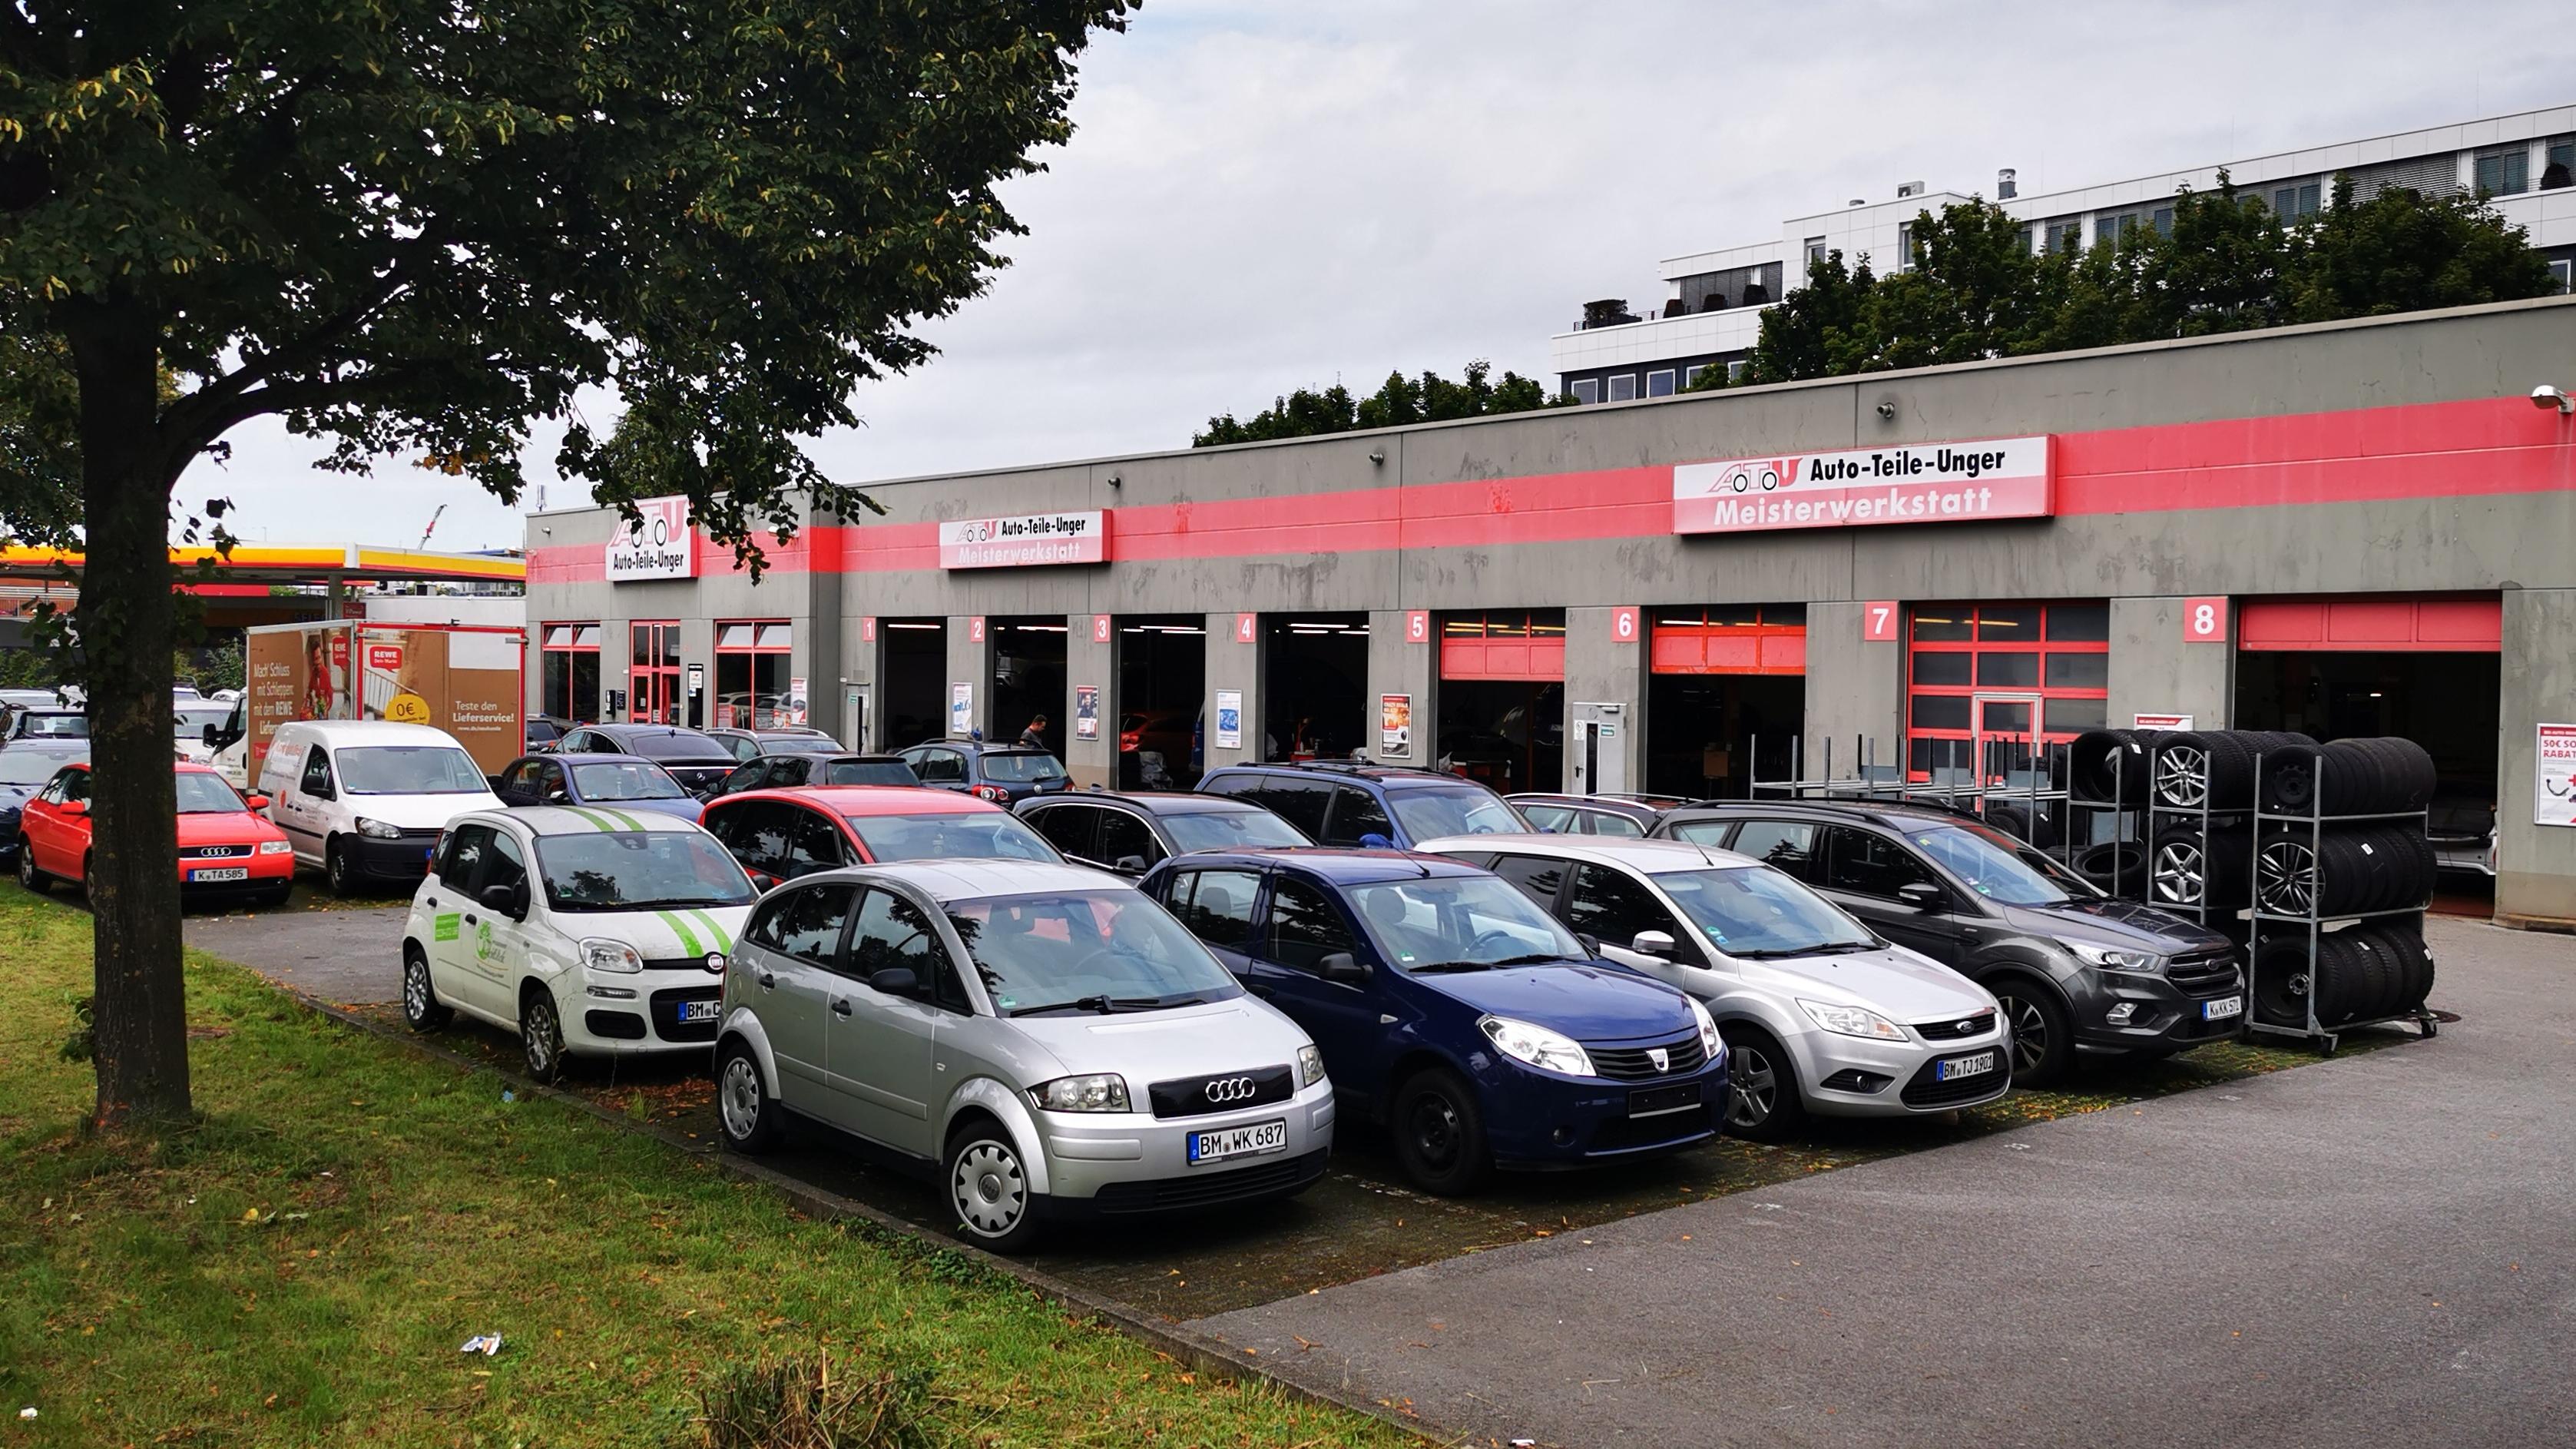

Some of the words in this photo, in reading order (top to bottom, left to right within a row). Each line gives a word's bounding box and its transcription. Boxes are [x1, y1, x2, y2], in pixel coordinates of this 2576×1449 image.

[1810, 449, 2005, 482] Auto-Teile-Unger
[1713, 487, 1992, 526] Meisterwerkstatt
[1002, 517, 1086, 536] Auto-Teile-Unger
[614, 550, 684, 572] Auto-Teile-Unger
[958, 542, 1081, 565] Meisterwerkstatt
[866, 621, 872, 638] 1
[974, 620, 982, 638] 2
[1098, 619, 1107, 638] 3
[1241, 618, 1252, 638] 4
[1412, 616, 1422, 638] 5
[1618, 613, 1632, 637] 6
[1872, 608, 1889, 635] 7
[2194, 604, 2215, 635] 8
[270, 663, 290, 677] Schluss
[275, 701, 293, 716] REWE
[455, 701, 478, 711] Teste
[481, 701, 497, 711] den
[453, 713, 515, 722] Lieferservice!
[198, 871, 204, 880] K
[211, 870, 223, 879] TA
[226, 870, 243, 878] 585
[688, 1003, 704, 1017] BM
[1944, 1063, 1956, 1078] BM
[1962, 1059, 1973, 1075] TJ
[1974, 1054, 1992, 1073] 1901
[1200, 1135, 1222, 1155] BM
[1233, 1129, 1252, 1150] WK
[1256, 1124, 1283, 1146] 687
